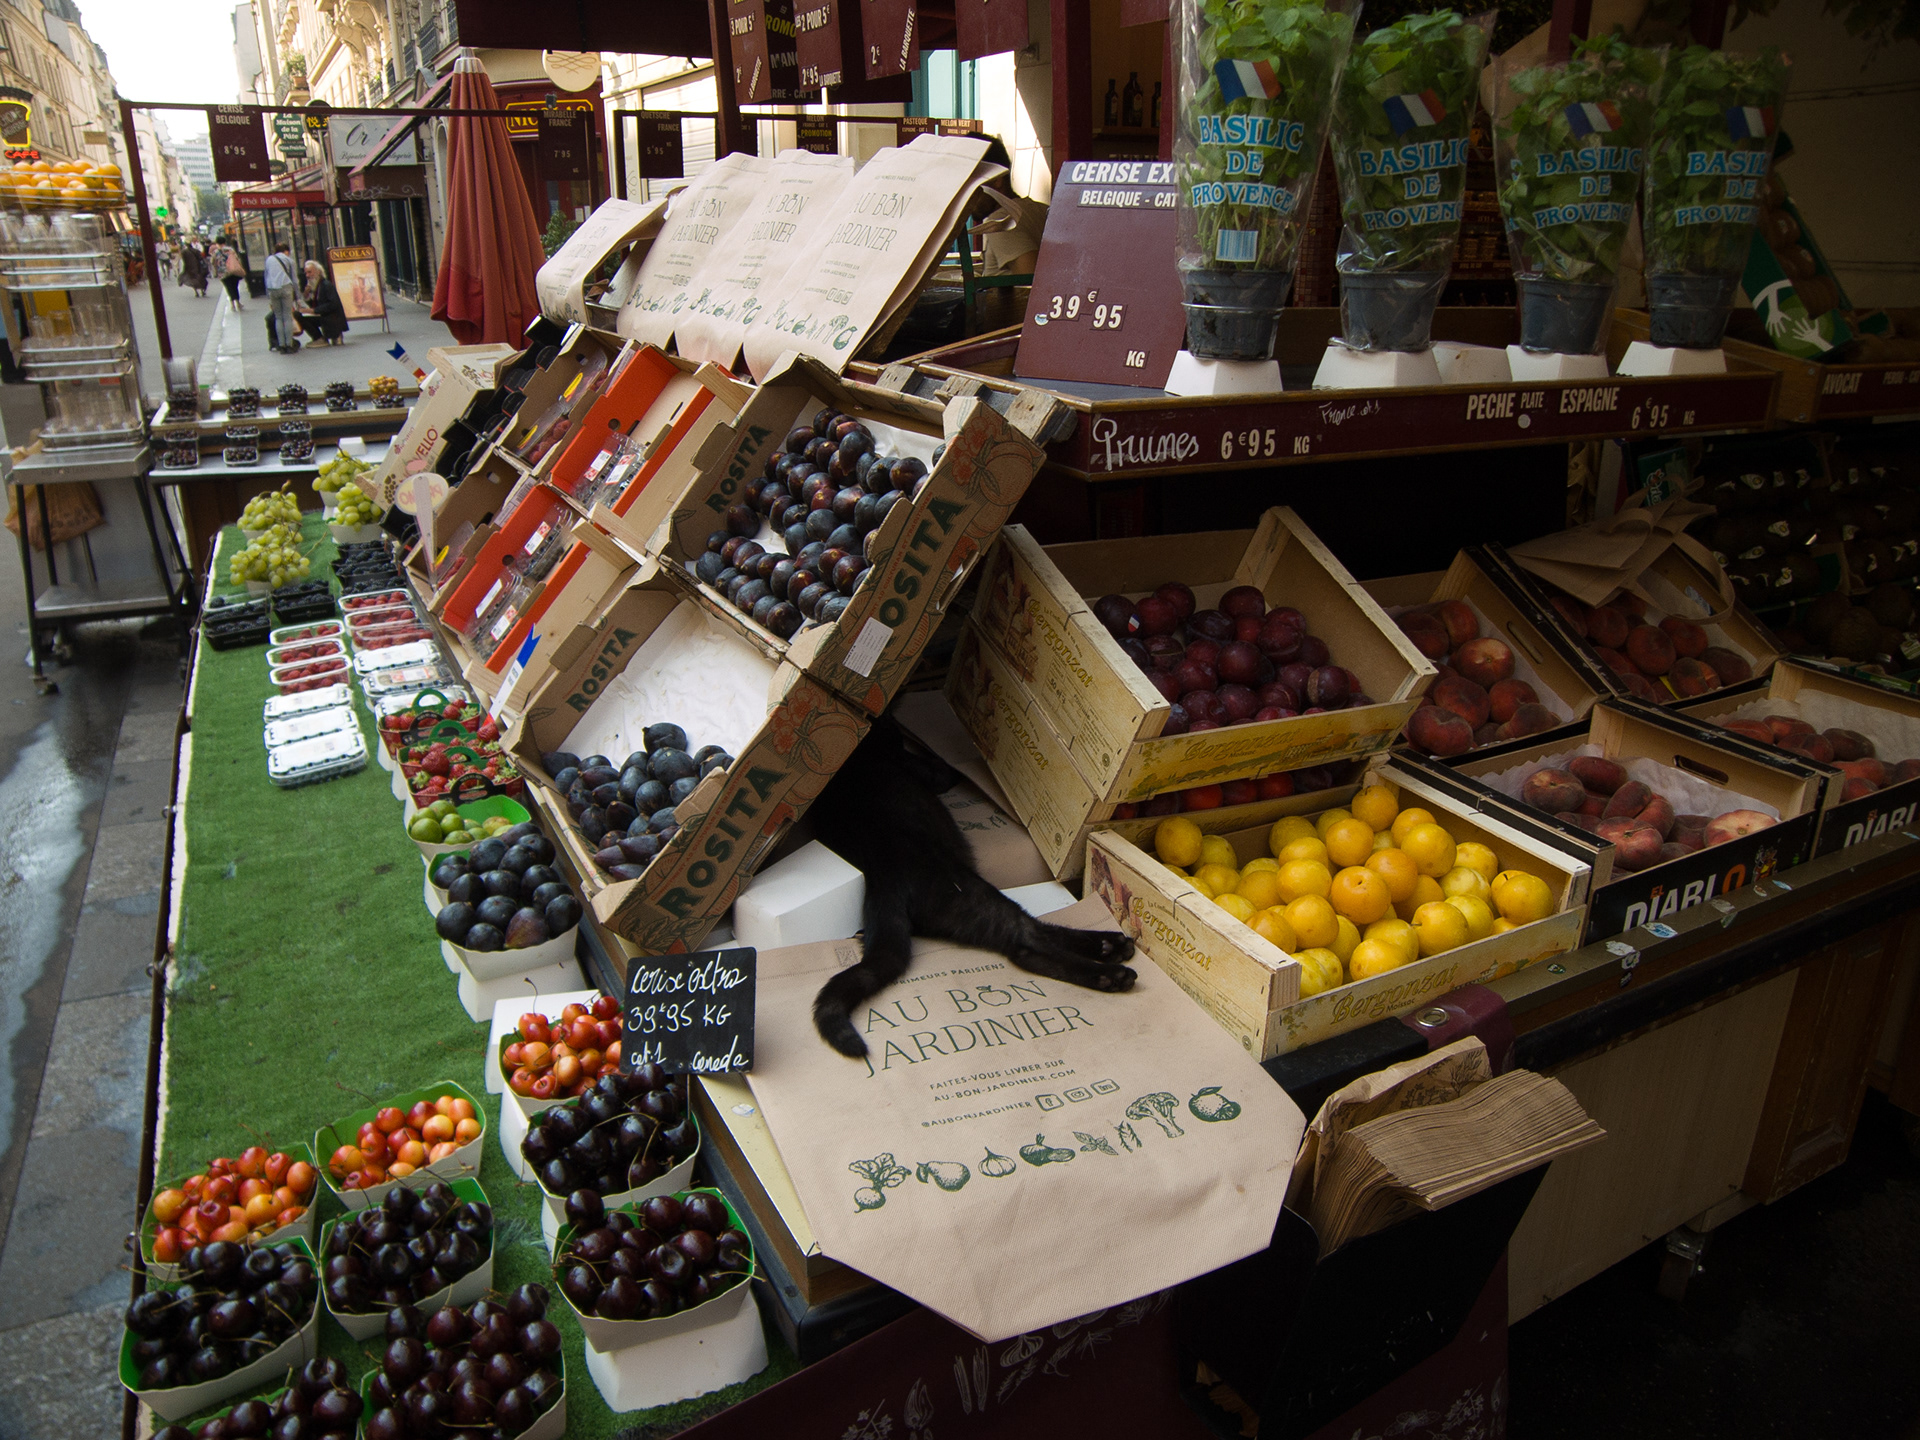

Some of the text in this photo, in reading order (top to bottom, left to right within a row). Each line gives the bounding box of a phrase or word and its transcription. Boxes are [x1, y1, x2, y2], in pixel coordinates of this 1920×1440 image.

[735, 17, 748, 35] POUR
[806, 9, 823, 31] POUR
[902, 7, 916, 59] BARQUETTE
[215, 115, 251, 125] BELGIQUE
[217, 104, 244, 113] CERISE
[543, 110, 577, 119] MIRABELLE
[640, 112, 671, 120] QUETSCHE
[548, 118, 572, 127] FRANCE
[657, 123, 680, 132] FRANCE
[800, 129, 833, 137] PROMOTION
[902, 117, 928, 126] PASTEQUE
[940, 119, 971, 128] MELON VERT
[1198, 114, 1304, 153] BASILIC
[1071, 162, 1144, 183] CERISE
[1225, 151, 1264, 176] DE
[1536, 146, 1643, 177] BASILIC
[1191, 182, 1294, 214] PROVENCE
[1403, 172, 1441, 200] DE
[1578, 174, 1612, 197] DE
[1723, 179, 1757, 199] DE
[1080, 190, 1142, 208] BELGIQUE
[825, 222, 898, 252] JARDINIER
[332, 249, 371, 258] NICOLAS
[1125, 350, 1146, 368] KG
[1821, 372, 1863, 395] AVOCAT
[1466, 392, 1516, 421] PECHE
[1520, 391, 1545, 410] PLATE
[1559, 386, 1621, 415] ESPAGNE
[1682, 410, 1696, 426] KG
[1092, 418, 1200, 473] Prunes
[1293, 435, 1310, 456] KG
[704, 424, 772, 514] ROSITA
[877, 496, 968, 657] OSITA
[1027, 598, 1093, 688] Bergonzat
[565, 627, 638, 712] ROSITA
[991, 683, 1049, 771] Bergonzat
[655, 765, 791, 920] ROSITA
[1650, 884, 1665, 898] EL
[1131, 896, 1213, 972] Bergonzat
[950, 962, 1005, 976] PARISIENS
[864, 979, 1048, 1034] AU BON
[1331, 962, 1459, 1026] Bergonzat
[1385, 996, 1416, 1014] Moissac
[702, 1003, 732, 1028] KG
[864, 1005, 1095, 1079] JARDINIER
[929, 1058, 1066, 1091] FAITES-VOUS LIVRER SUR
[933, 1068, 1077, 1102] AU-BON-JARDINIER.COM
[921, 1100, 1033, 1128] @AUBONJARDINIER
